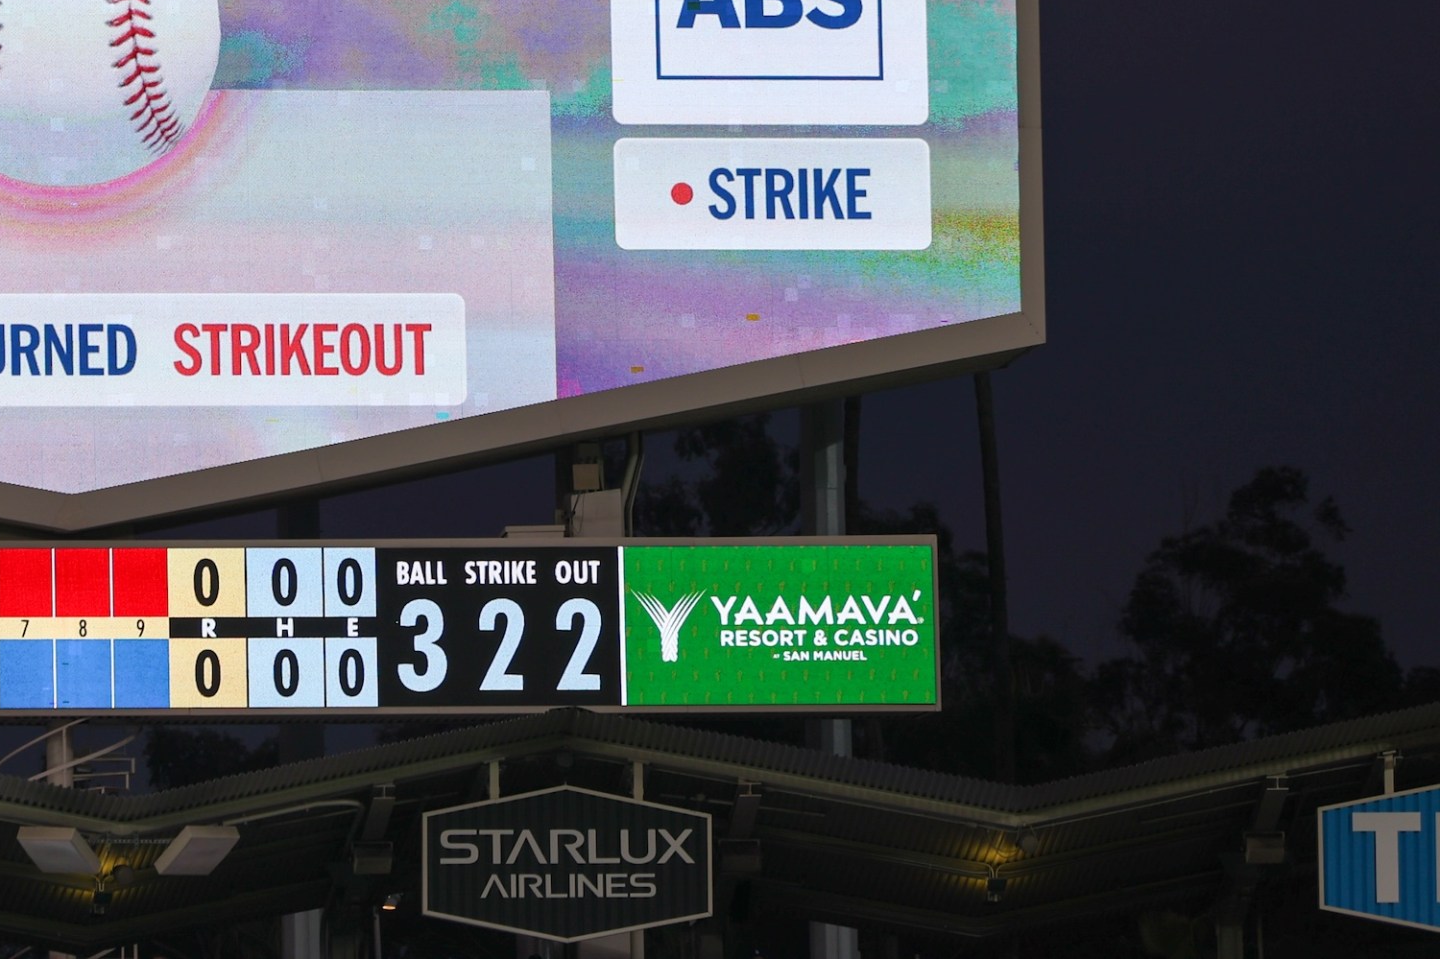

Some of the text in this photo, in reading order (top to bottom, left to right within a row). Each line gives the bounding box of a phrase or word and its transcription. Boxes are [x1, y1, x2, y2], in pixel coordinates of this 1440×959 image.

[708, 168, 872, 220] STRIKE
[173, 323, 432, 376] STRIKEOUT
[193, 558, 363, 607] 0 0 0
[396, 560, 601, 585] BALL STRIKE OUT
[20, 620, 29, 638] 7
[78, 620, 87, 638] 8
[136, 620, 145, 638] 9
[201, 618, 218, 638] R
[276, 618, 294, 638] H
[347, 618, 359, 638] E
[397, 598, 602, 692] 3 2 2
[720, 629, 919, 646] RESORT & CASINO
[195, 648, 365, 697] 0 0 0
[783, 650, 809, 661] SAN
[813, 650, 867, 661] MANUEL
[440, 829, 695, 865] STARLUX
[1352, 811, 1440, 903] T
[480, 873, 657, 898] AIRLINES
